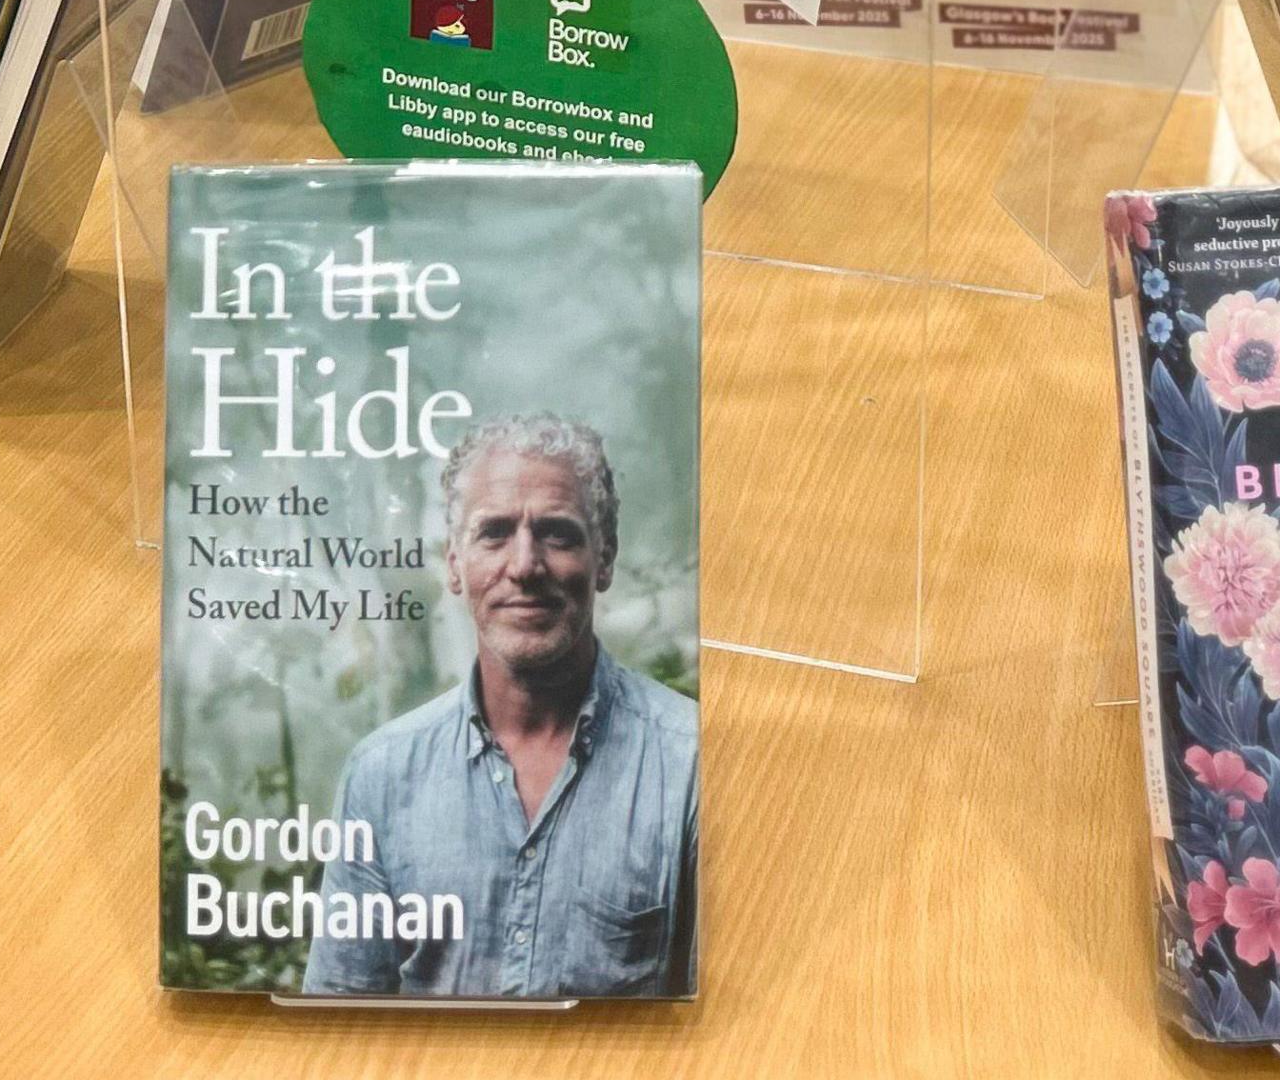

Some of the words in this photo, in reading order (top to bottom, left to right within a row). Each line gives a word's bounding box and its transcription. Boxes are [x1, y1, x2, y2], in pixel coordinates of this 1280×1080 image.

[755, 9, 785, 21] 6-16
[548, 40, 595, 68] Box.
[549, 18, 629, 52] Borrow
[382, 68, 471, 98] Download
[476, 87, 507, 104] our
[512, 91, 613, 122] Borrowbox
[618, 109, 654, 129] and
[388, 93, 437, 119] Libby
[442, 105, 477, 125] app
[482, 110, 500, 127] to
[504, 116, 568, 139] access
[573, 127, 606, 145] our
[610, 132, 646, 153] free
[402, 123, 518, 154] eaudiobooks
[523, 143, 558, 161] and
[1216, 214, 1280, 233] 'Joyously
[1194, 237, 1259, 252] seductive
[190, 227, 293, 320] In
[314, 225, 462, 320] the
[190, 345, 473, 459] Hide
[188, 484, 270, 516] How
[278, 485, 329, 516] the
[188, 536, 314, 568] Natural
[321, 536, 425, 568] World
[188, 587, 282, 620] Saved
[292, 589, 349, 631] My
[358, 589, 425, 621] Life
[185, 801, 374, 862] Gordon
[186, 873, 464, 940] Buchanan
